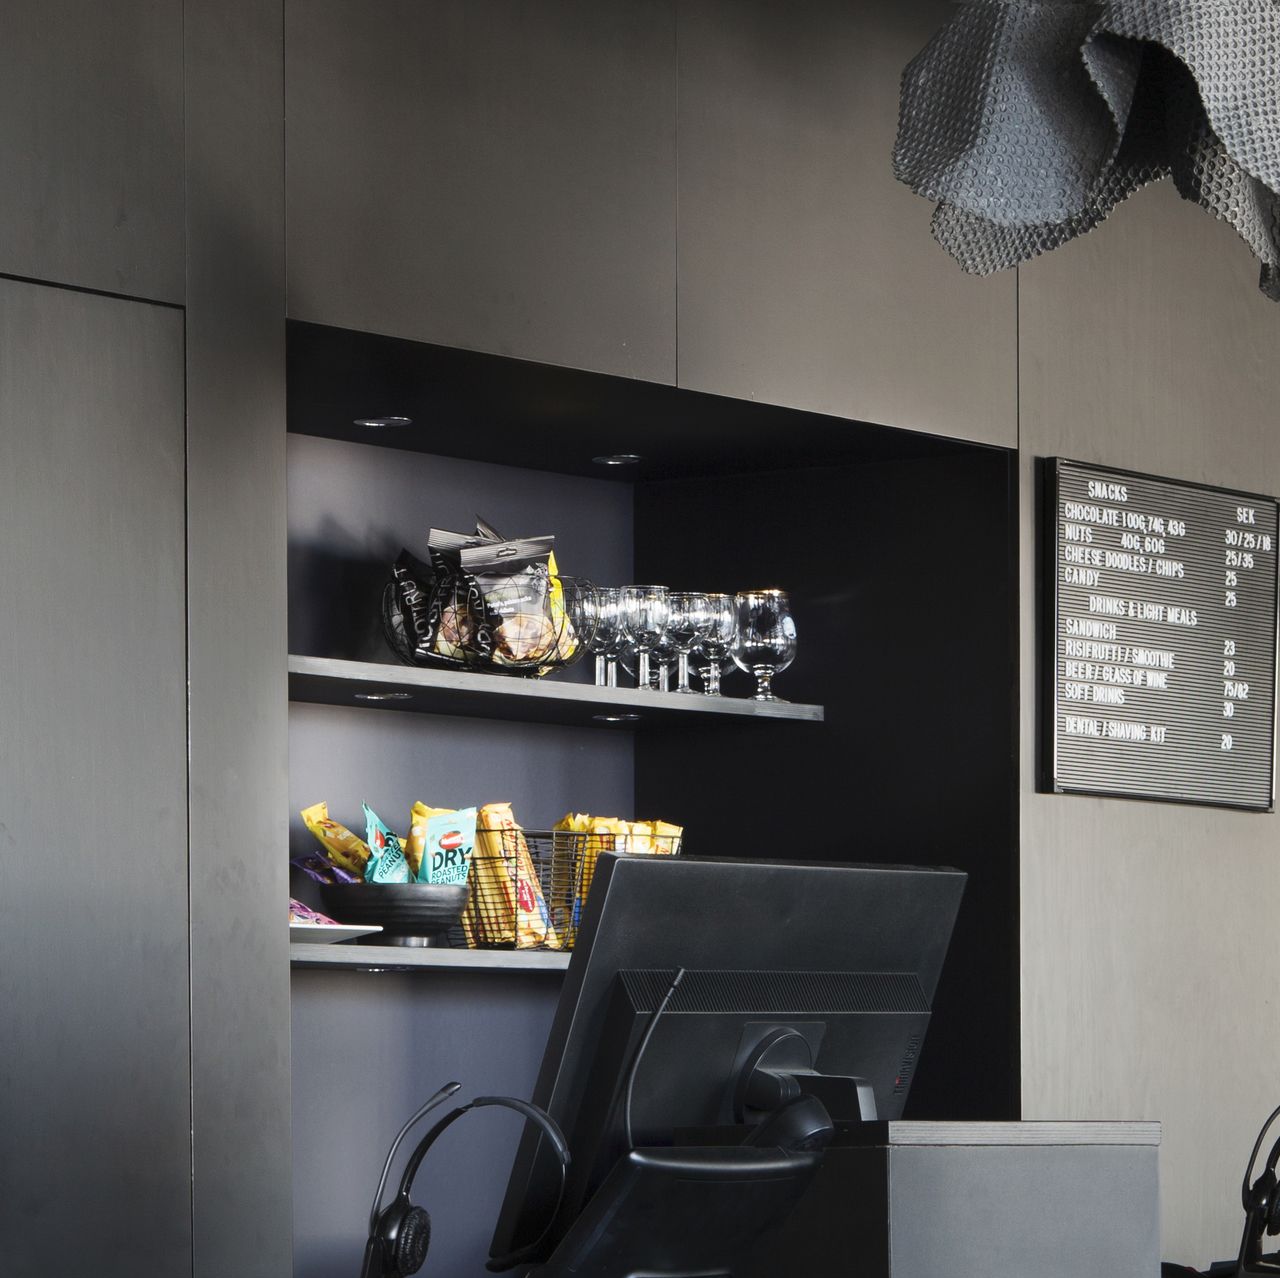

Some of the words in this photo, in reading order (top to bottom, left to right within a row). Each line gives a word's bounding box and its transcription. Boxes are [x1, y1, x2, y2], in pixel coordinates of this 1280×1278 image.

[1065, 503, 1119, 526] CHOCOLATE
[1168, 520, 1186, 536] 43G
[1088, 481, 1128, 501] SNACKS
[1236, 507, 1255, 524] SEK
[1065, 524, 1092, 543] NUTS
[1225, 550, 1254, 568] 25/35
[1065, 544, 1102, 566] CHEESE
[1105, 551, 1146, 572] DOODLES
[1156, 560, 1184, 578] CHIPS
[1225, 570, 1237, 586] 25
[1065, 567, 1100, 586] CANDY
[1225, 591, 1237, 607] 25
[1089, 596, 1125, 615] DRINKS
[1128, 601, 1135, 617] &
[1137, 603, 1164, 621] LIGHT
[1167, 607, 1197, 626] MEALS
[1065, 619, 1116, 639] SANDWICH
[1224, 640, 1235, 656] 23
[1065, 640, 1121, 661] RISIFRUTTI
[1132, 648, 1175, 668] SMOOTHIE
[1223, 661, 1235, 676] 20
[1065, 661, 1092, 679] BEER
[1102, 666, 1131, 683] GLASS
[1133, 670, 1145, 685] OF
[1146, 671, 1168, 688] WINE
[1065, 683, 1090, 700] SOFT
[1093, 686, 1125, 704] DRINKS
[1223, 702, 1234, 717] 30
[1065, 715, 1100, 736] DENTAL
[1108, 721, 1147, 740] SHAVING
[1150, 726, 1166, 743] KIT
[1221, 734, 1233, 750] 20
[431, 865, 468, 880] ROASTED
[432, 847, 473, 872] DRY
